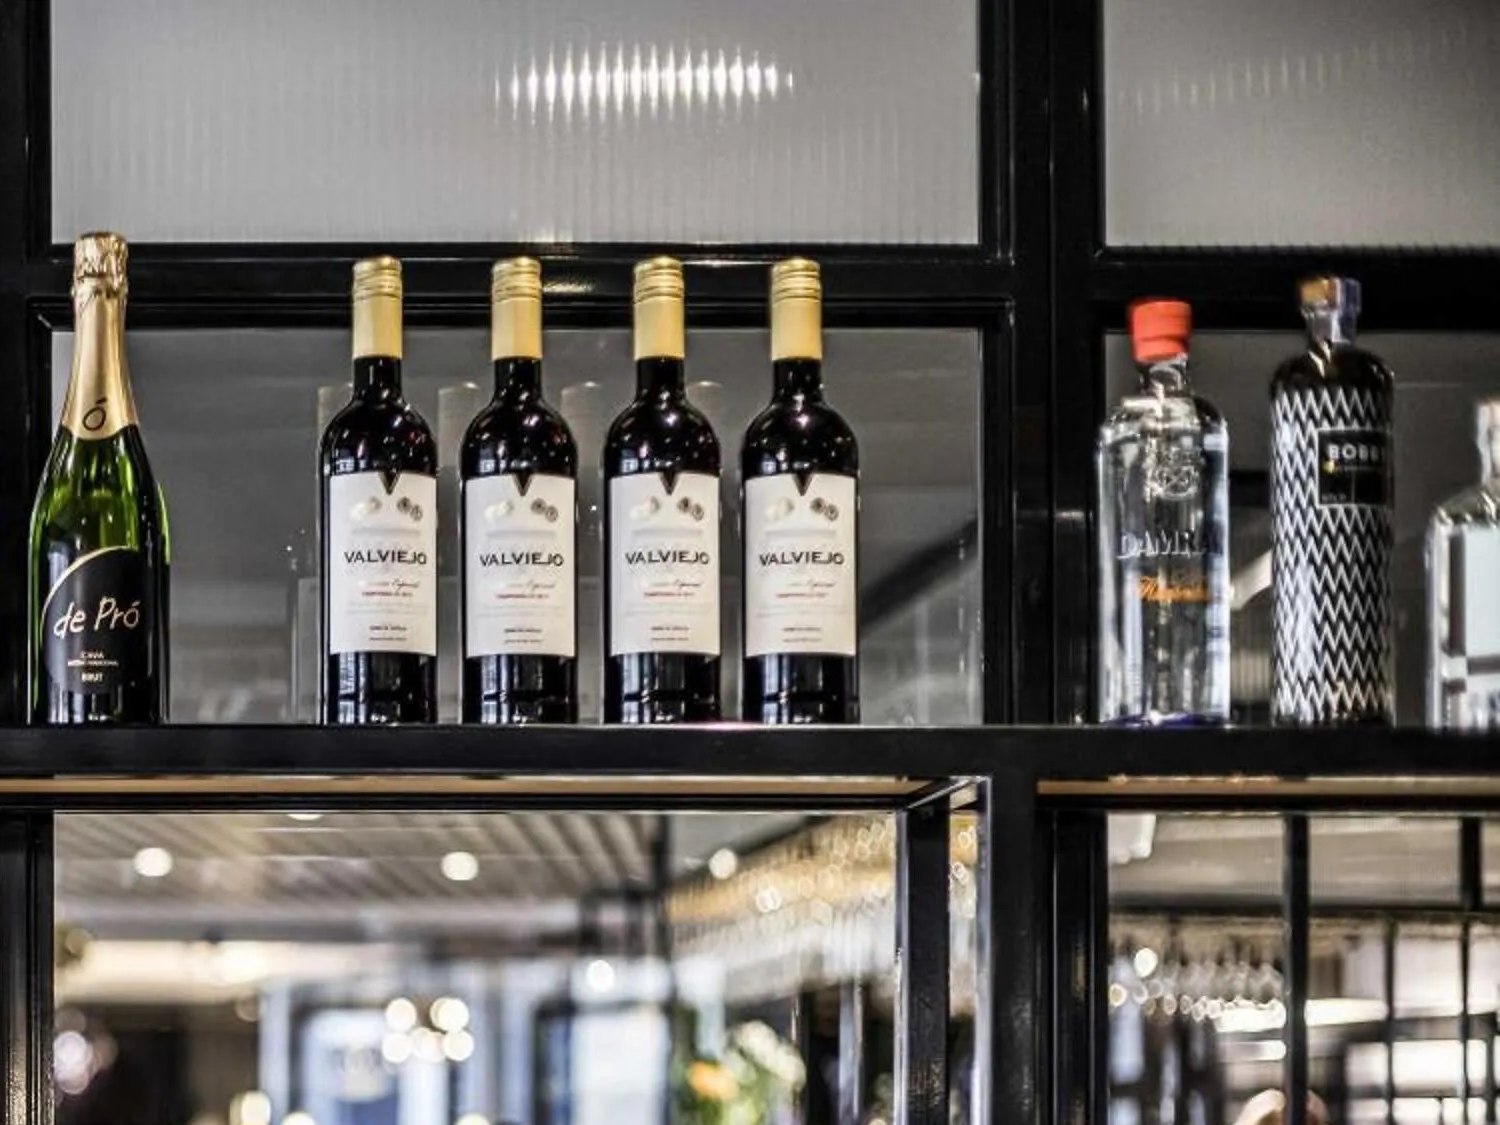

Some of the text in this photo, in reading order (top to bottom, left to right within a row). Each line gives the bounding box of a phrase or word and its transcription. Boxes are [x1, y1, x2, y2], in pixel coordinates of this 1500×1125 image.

[1327, 443, 1379, 461] BOBB
[343, 549, 427, 565] VALVIEJO
[479, 551, 564, 567] VALVIEJO
[625, 550, 710, 565] VALVIEJO
[759, 551, 845, 566] VALVIEJO
[53, 596, 141, 639] de Pró
